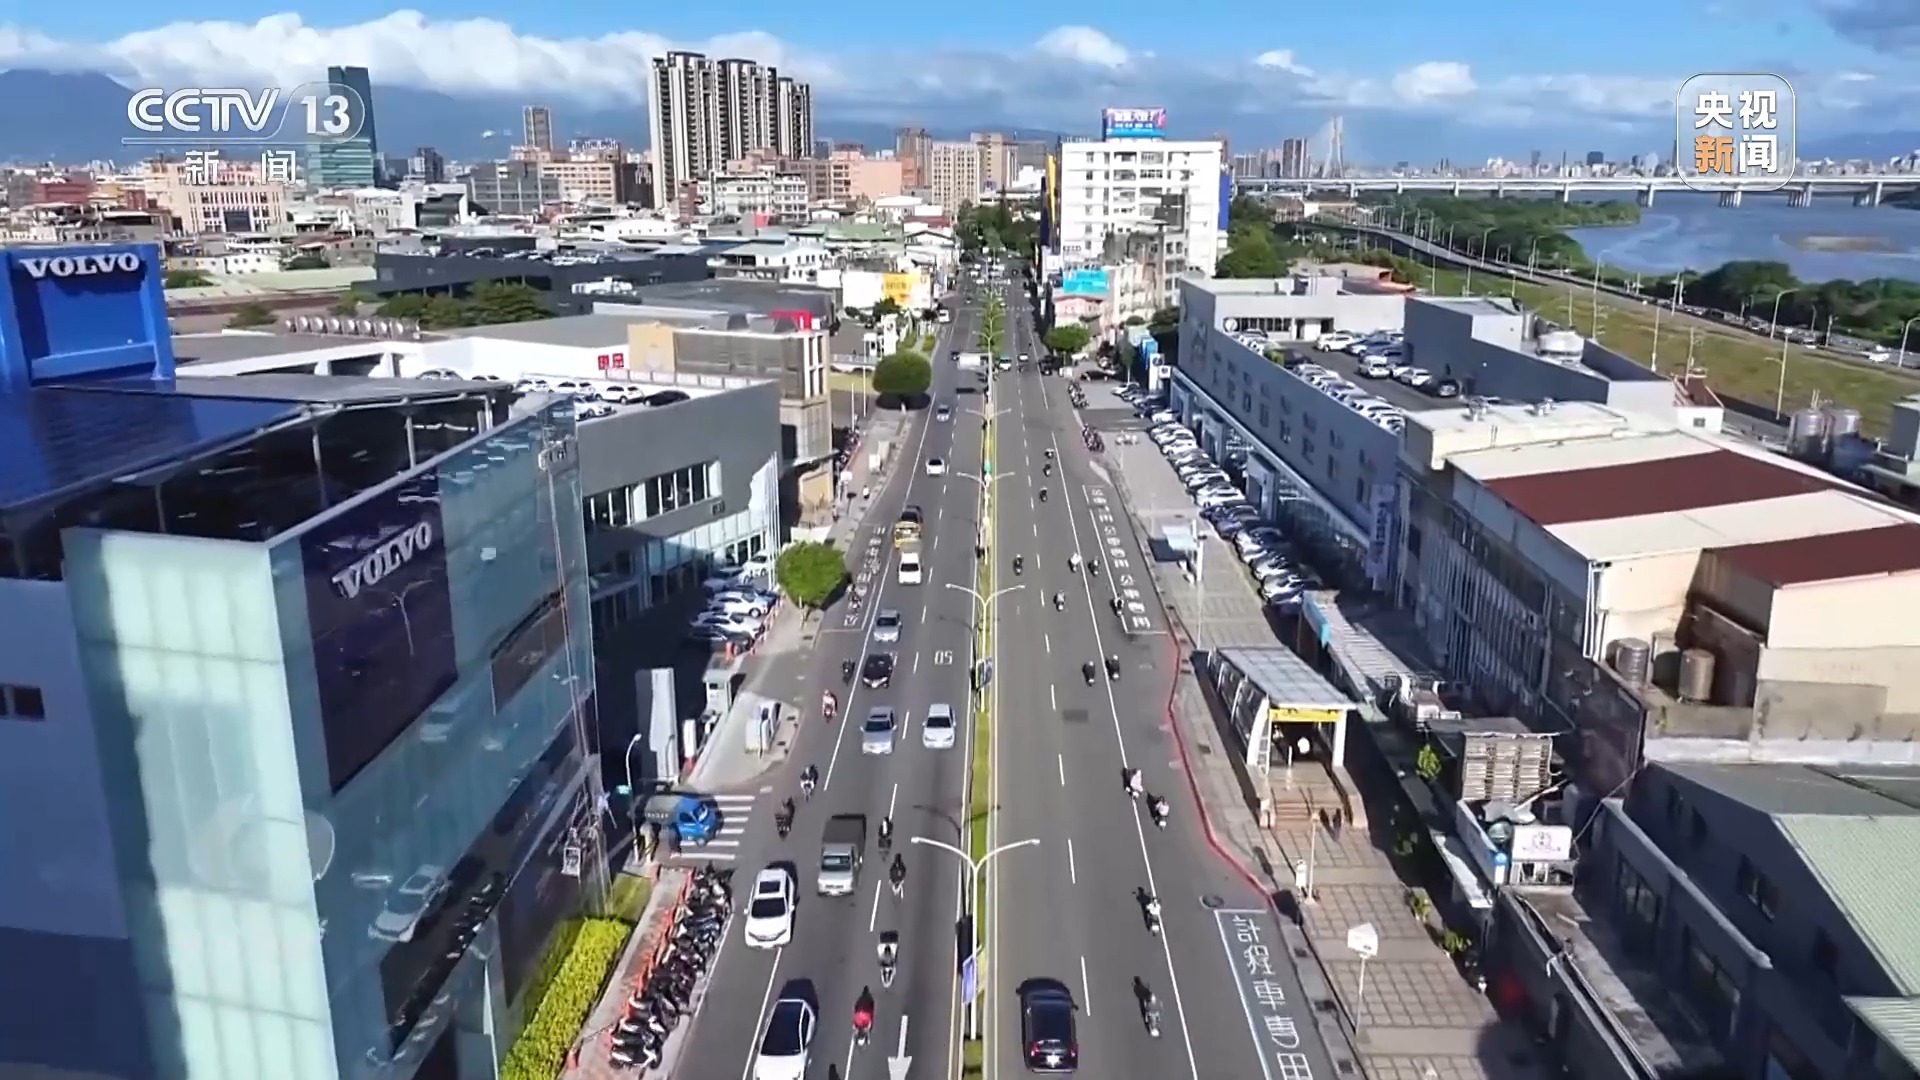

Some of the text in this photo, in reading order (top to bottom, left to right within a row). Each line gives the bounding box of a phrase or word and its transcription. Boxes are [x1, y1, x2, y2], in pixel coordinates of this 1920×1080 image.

[19, 252, 140, 279] VOLVO
[331, 521, 433, 599] VOLVO
[934, 649, 953, 665] 50
